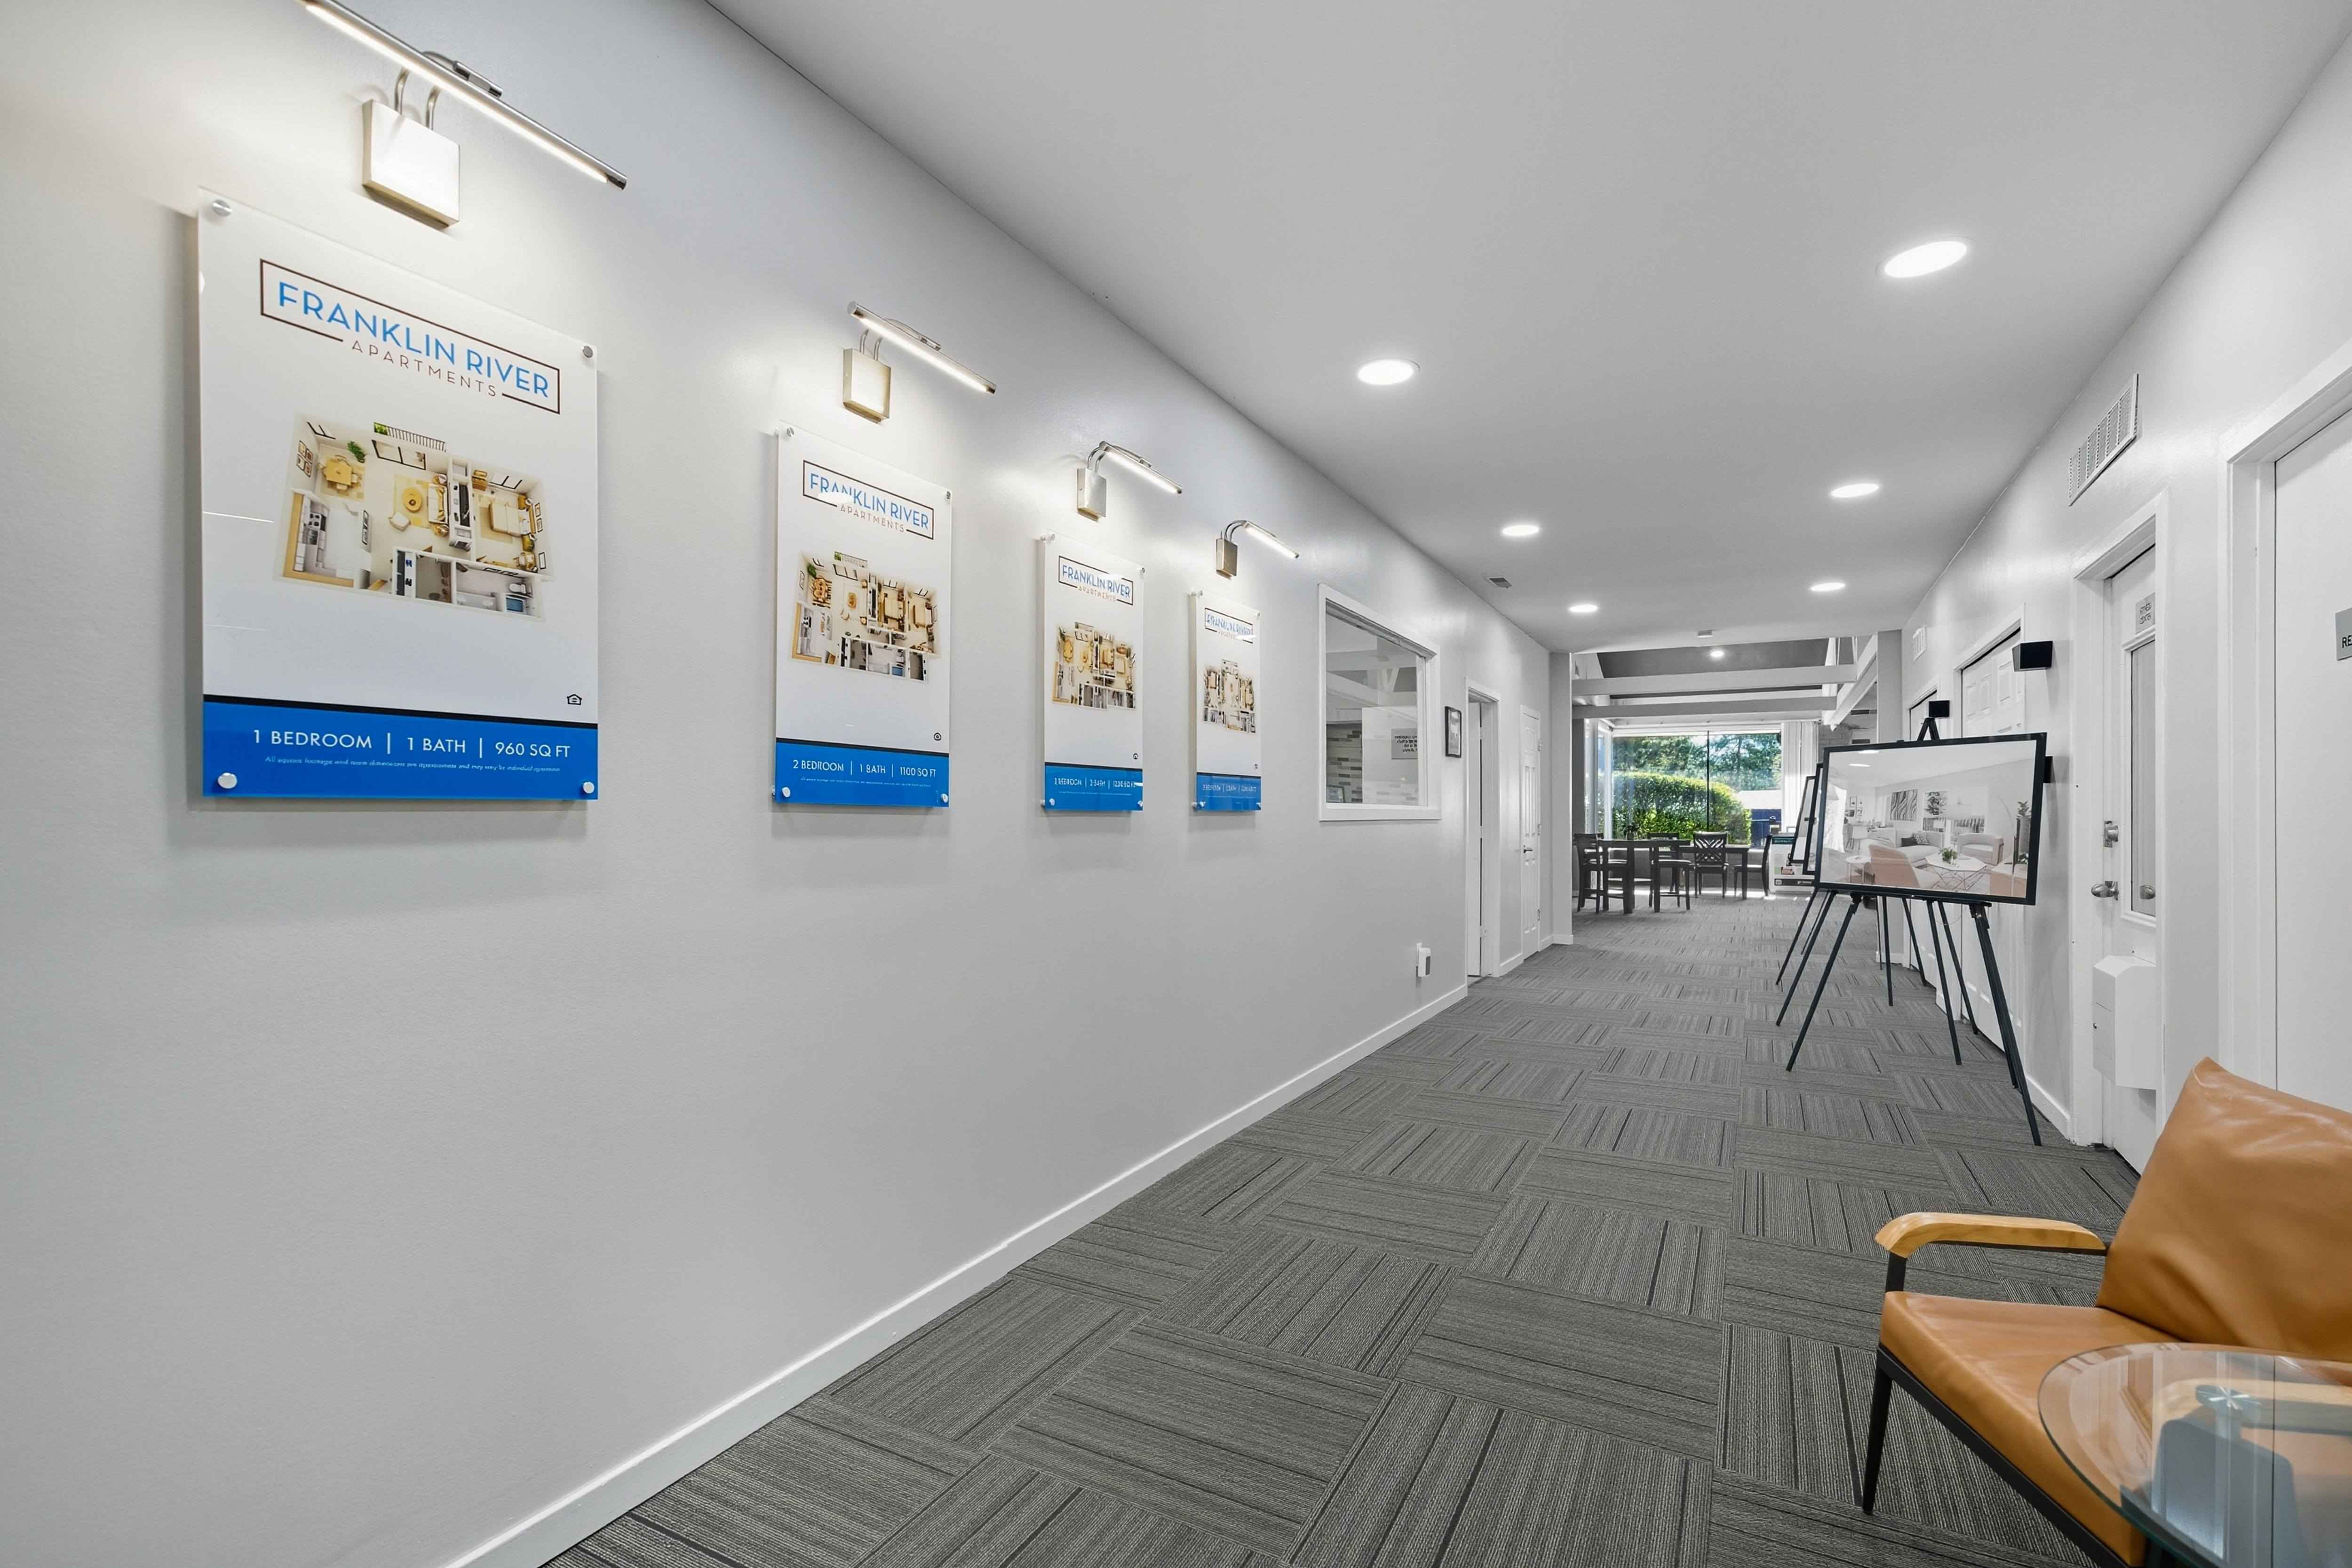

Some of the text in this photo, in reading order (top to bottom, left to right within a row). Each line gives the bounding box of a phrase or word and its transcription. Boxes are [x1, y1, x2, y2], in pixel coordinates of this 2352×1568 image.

[278, 281, 549, 398] FRANKLIN RIVER
[352, 340, 496, 397] APARTMENTS
[810, 473, 928, 529] FRANKLIN RIVER
[841, 504, 904, 532] APARTMENTS
[1062, 565, 1130, 598] FRANKLIN RIVER
[254, 730, 571, 757] 1 BEDROOM 1 BATH 960 SQ FT
[793, 760, 798, 769] 2
[801, 760, 844, 772] BEDROOM
[860, 764, 863, 772] 1
[900, 767, 916, 776] 1100
[930, 769, 936, 778] FT
